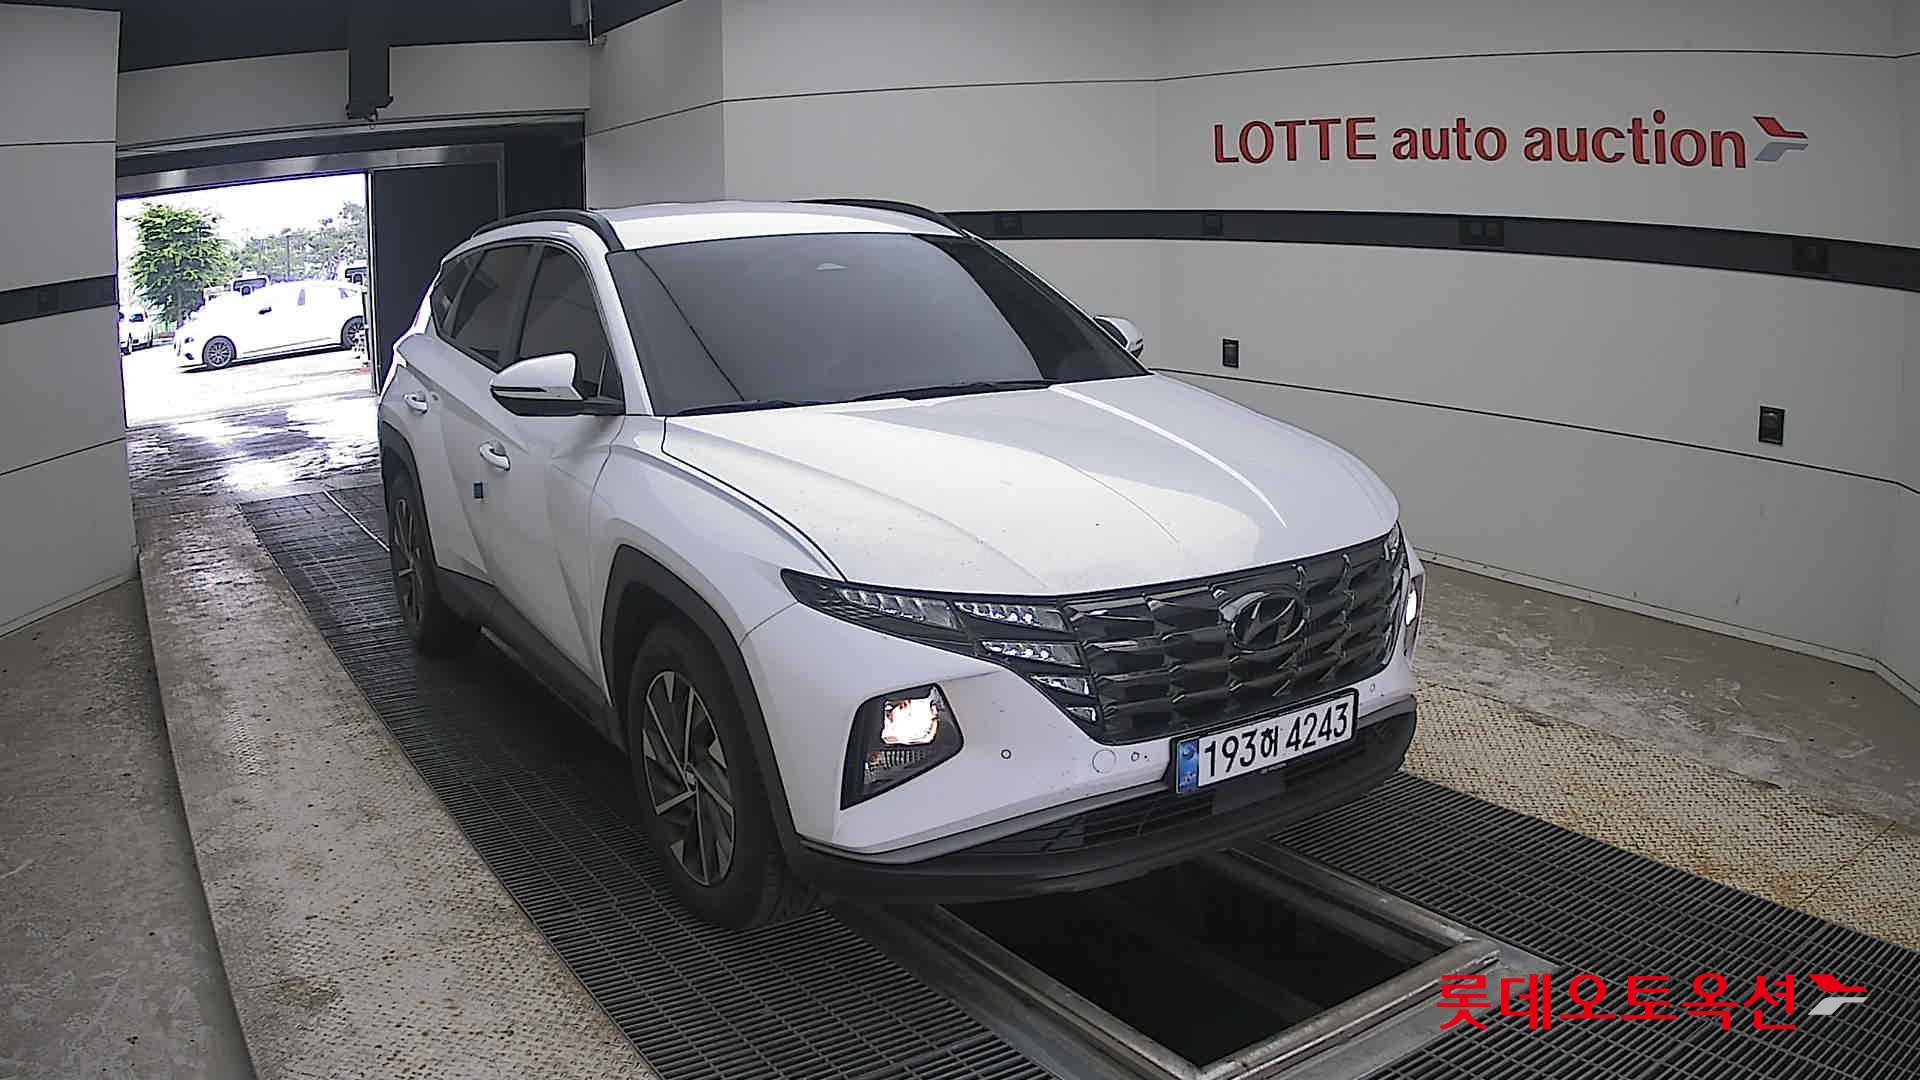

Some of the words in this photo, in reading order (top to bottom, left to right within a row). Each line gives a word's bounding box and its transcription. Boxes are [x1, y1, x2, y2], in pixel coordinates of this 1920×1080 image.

[1214, 116, 1377, 164] LOTTE
[1392, 117, 1508, 161] auto
[1523, 109, 1747, 168] auction
[1205, 725, 1279, 777] 193허
[1286, 702, 1349, 752] 4243
